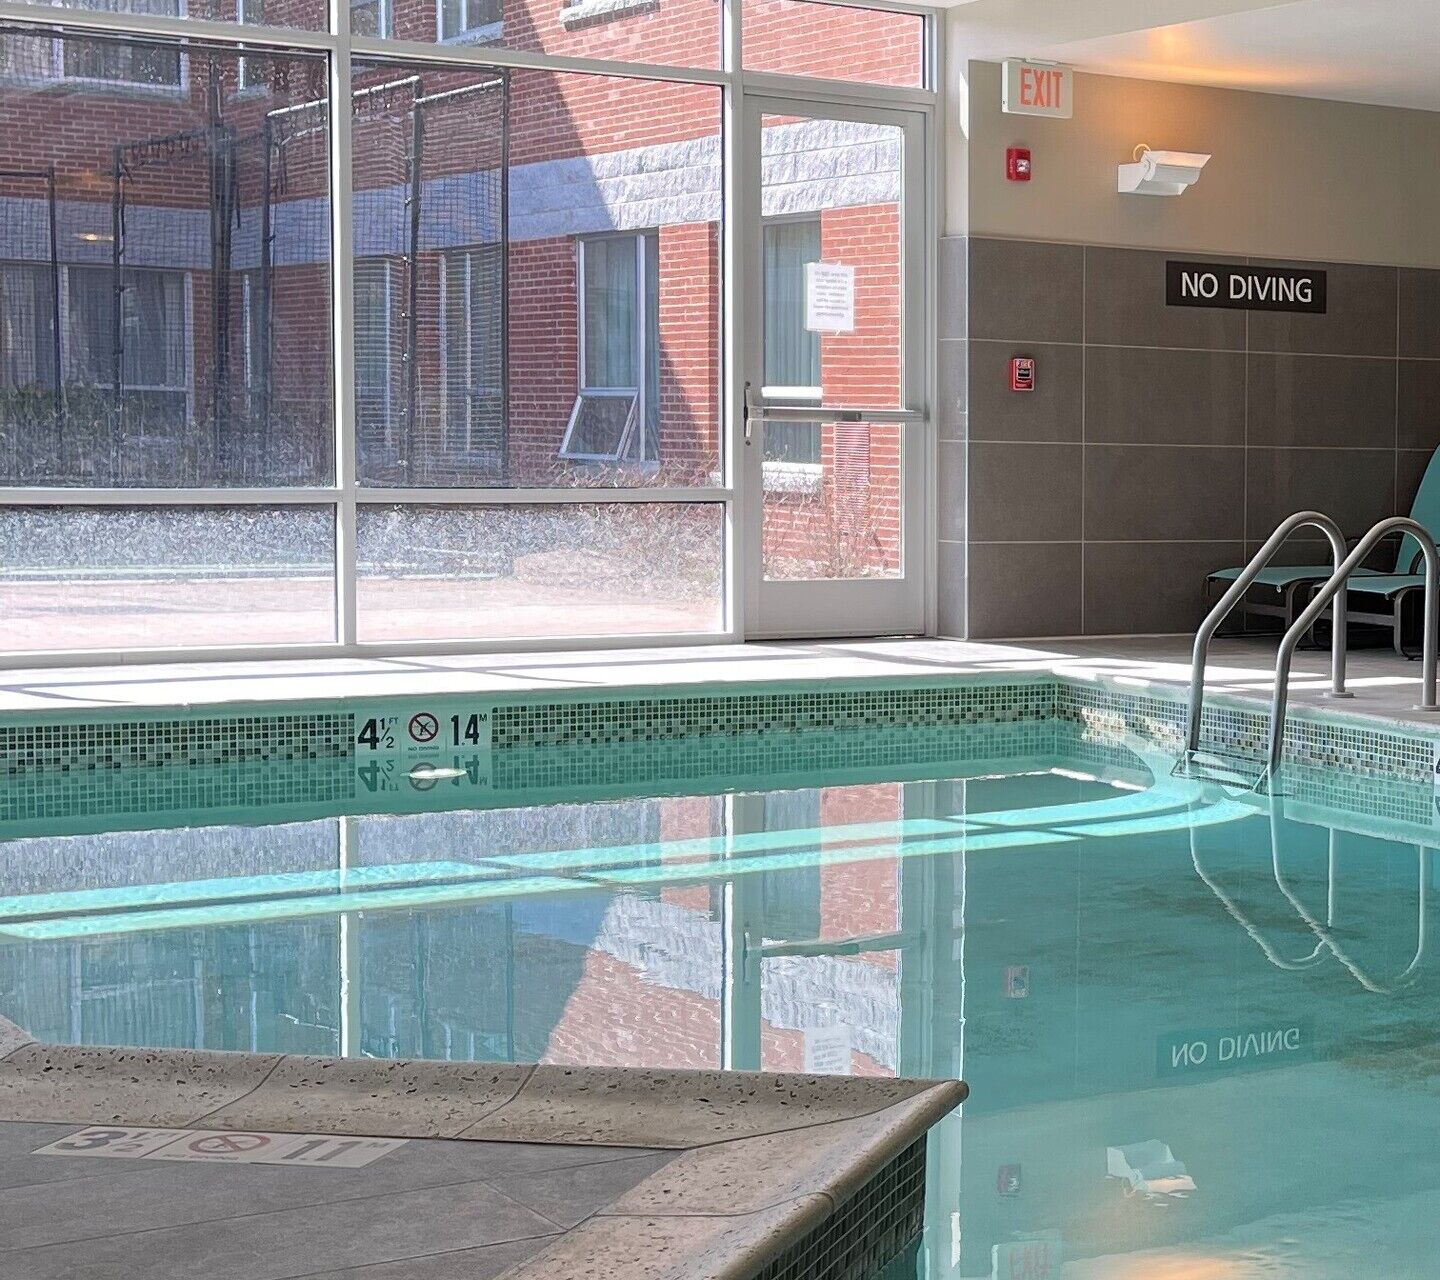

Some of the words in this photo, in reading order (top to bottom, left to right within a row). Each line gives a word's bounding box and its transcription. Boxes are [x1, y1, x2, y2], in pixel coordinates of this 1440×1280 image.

[1020, 68, 1063, 108] EXIT
[1181, 272, 1219, 298] NO
[1229, 274, 1312, 303] DIVING
[479, 713, 488, 722] M
